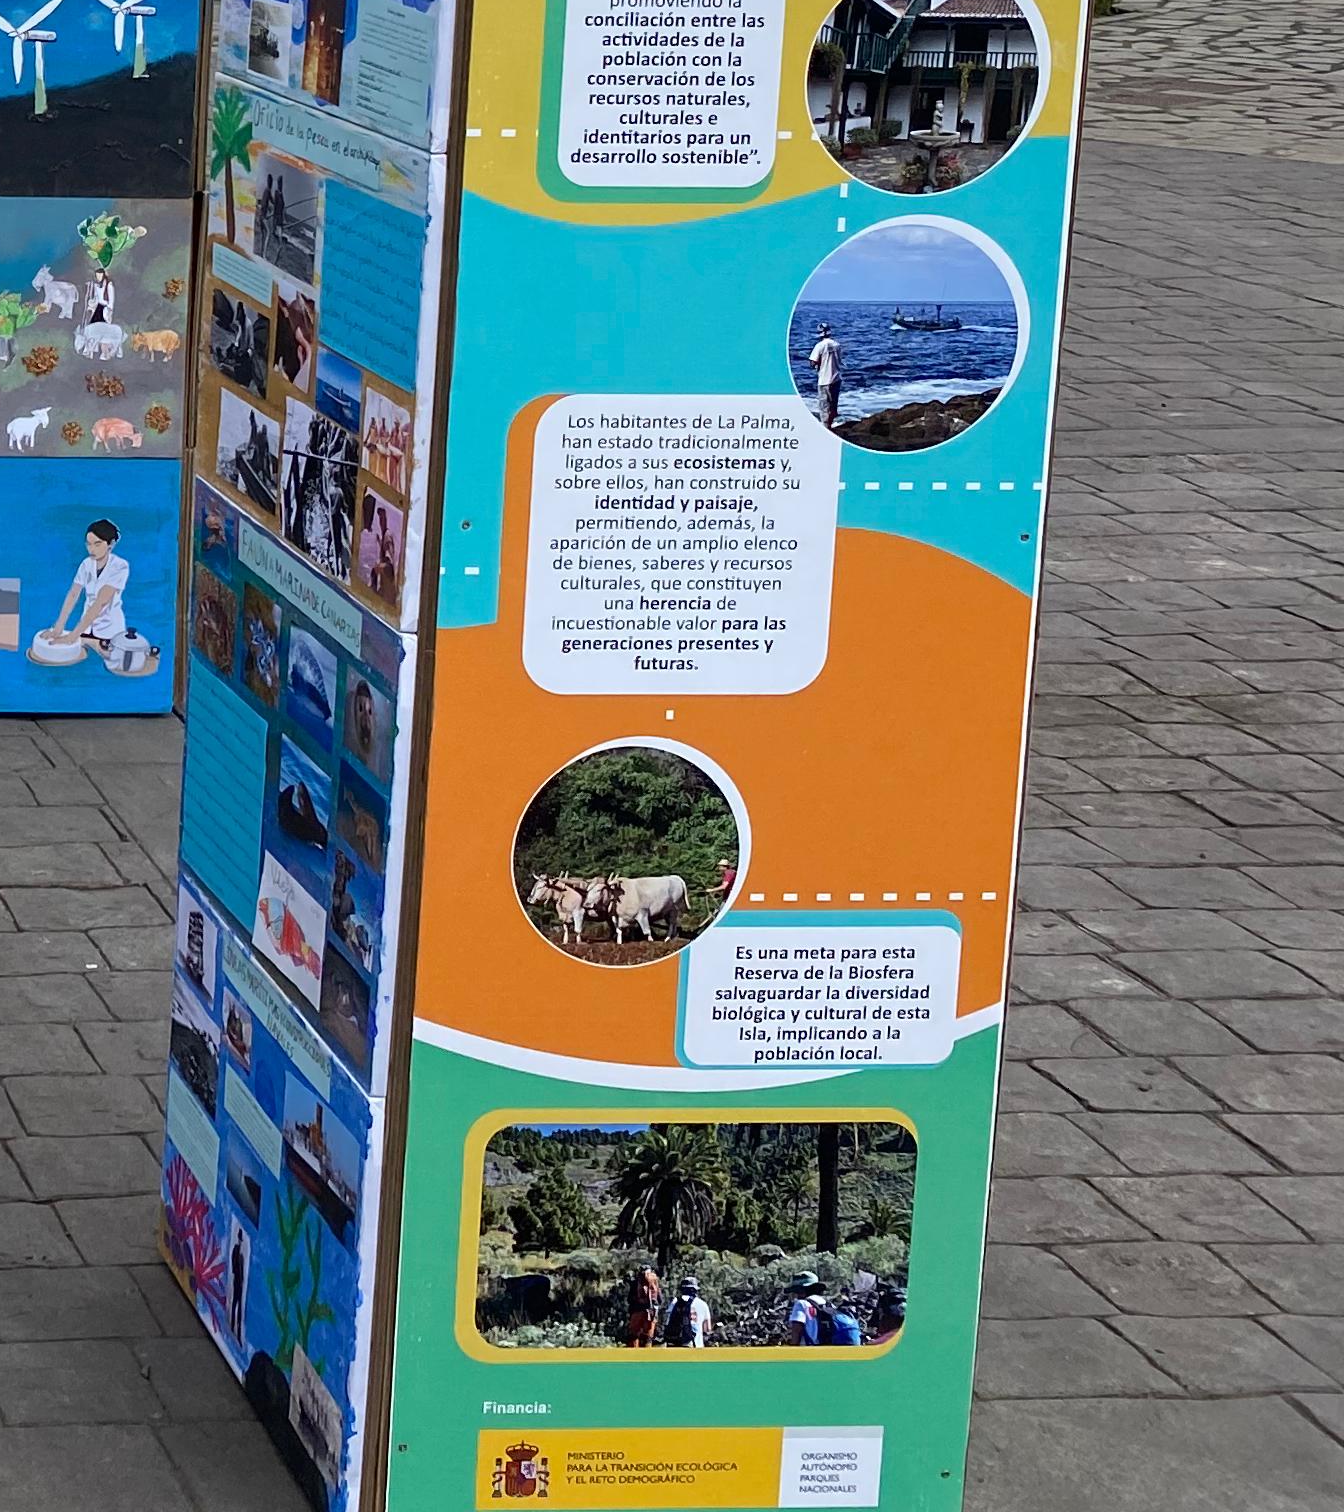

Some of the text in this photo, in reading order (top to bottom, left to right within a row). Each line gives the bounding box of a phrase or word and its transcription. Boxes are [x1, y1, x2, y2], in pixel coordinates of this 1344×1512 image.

[737, 947, 915, 962] Es una meta para esta
[735, 964, 913, 980] Reserva de la Biosfera
[715, 985, 929, 1003] salvaguardar la diversidad
[712, 1005, 929, 1024] biológica y cultural de esta
[740, 1026, 900, 1043] Isla, implicando a la
[754, 1045, 883, 1064] población local.
[484, 1401, 551, 1414] Financia:
[567, 1451, 625, 1460] MINISTERIO
[801, 1452, 858, 1461] ORGANISMO
[566, 1461, 738, 1472] PARA LA TRANSICIÓN ECOLÓGICA
[800, 1462, 858, 1471] AUTÓNOMO
[566, 1473, 696, 1484] Y EL RETO DEMOGRÁFICO
[799, 1474, 840, 1483] PARQUES
[799, 1485, 857, 1493] NACIONALES
